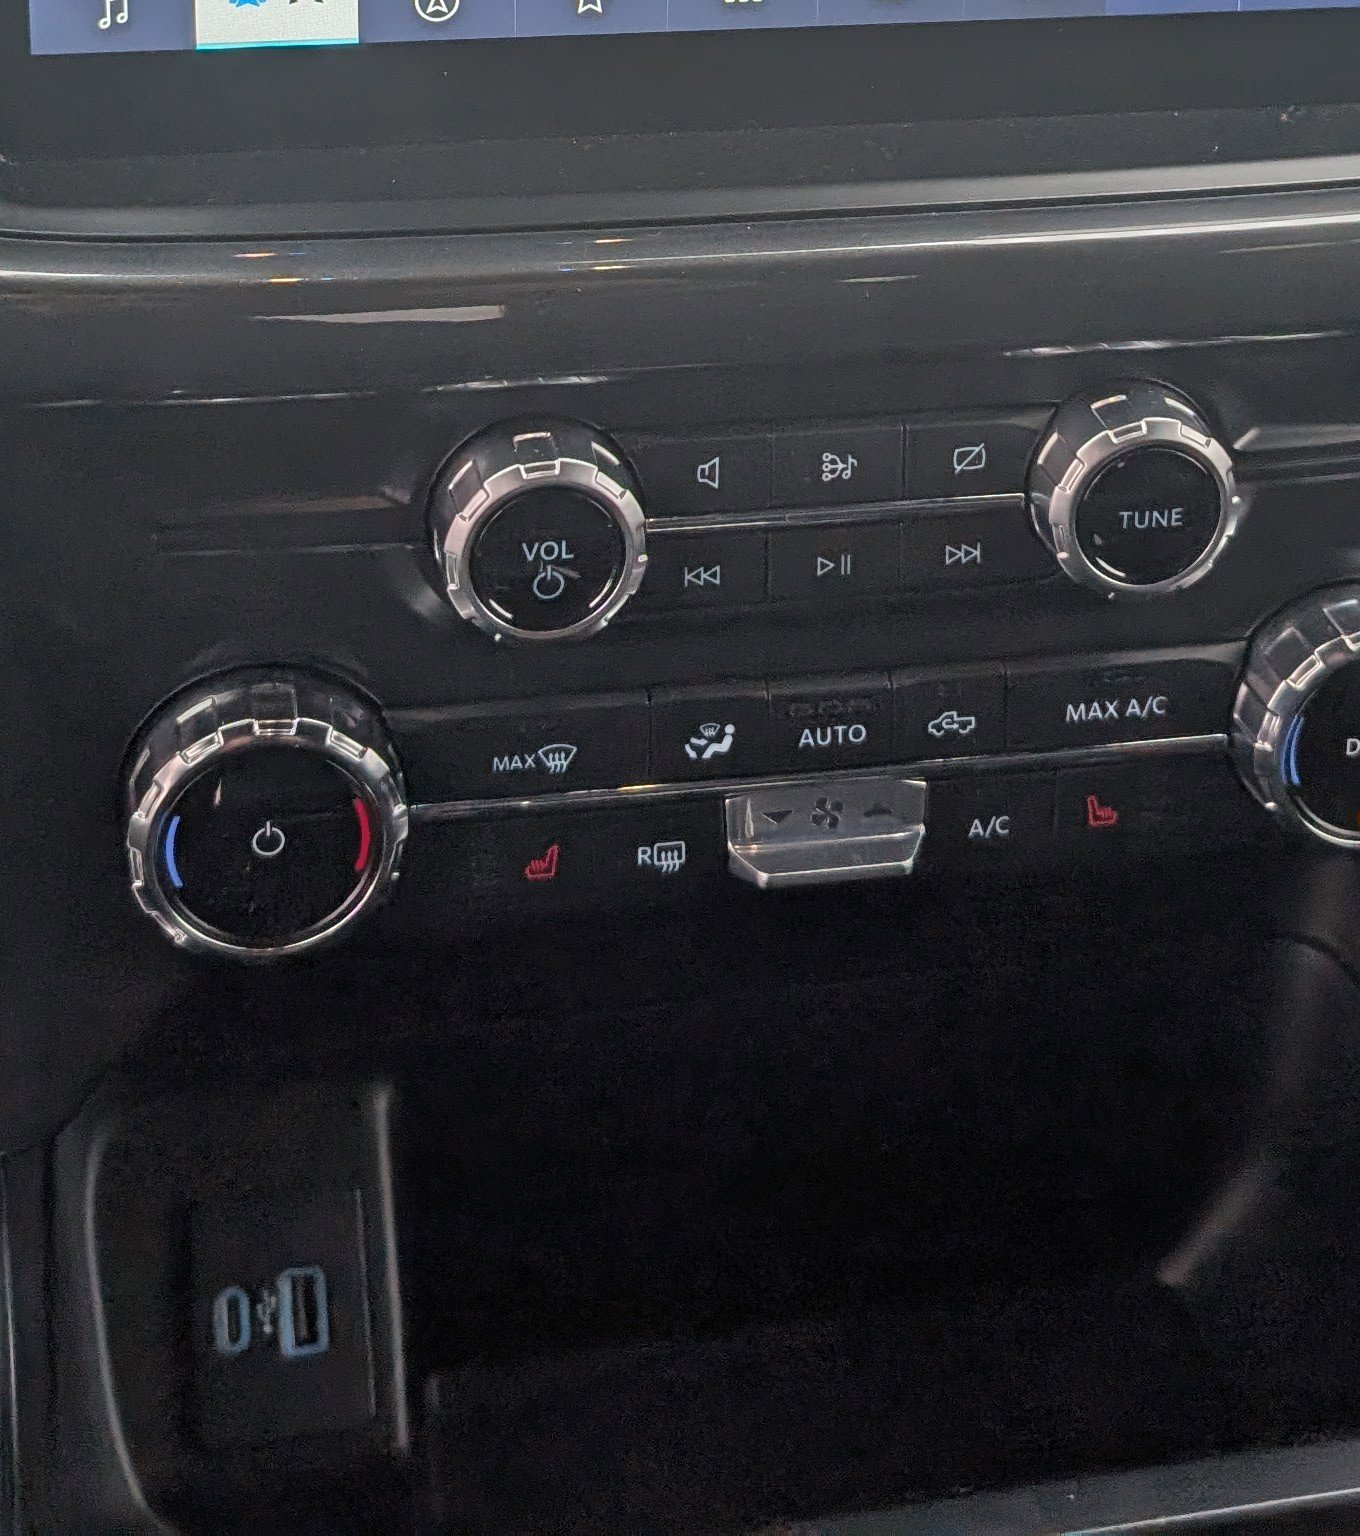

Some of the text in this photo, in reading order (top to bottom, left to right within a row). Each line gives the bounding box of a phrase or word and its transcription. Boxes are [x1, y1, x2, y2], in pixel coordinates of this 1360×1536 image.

[1118, 507, 1185, 531] TUNE
[521, 540, 575, 563] VOL
[1065, 695, 1169, 723] MAX A/C
[798, 723, 867, 749] AUTO
[492, 752, 537, 773] MAX
[968, 815, 1010, 838] A/C
[637, 846, 652, 866] R
